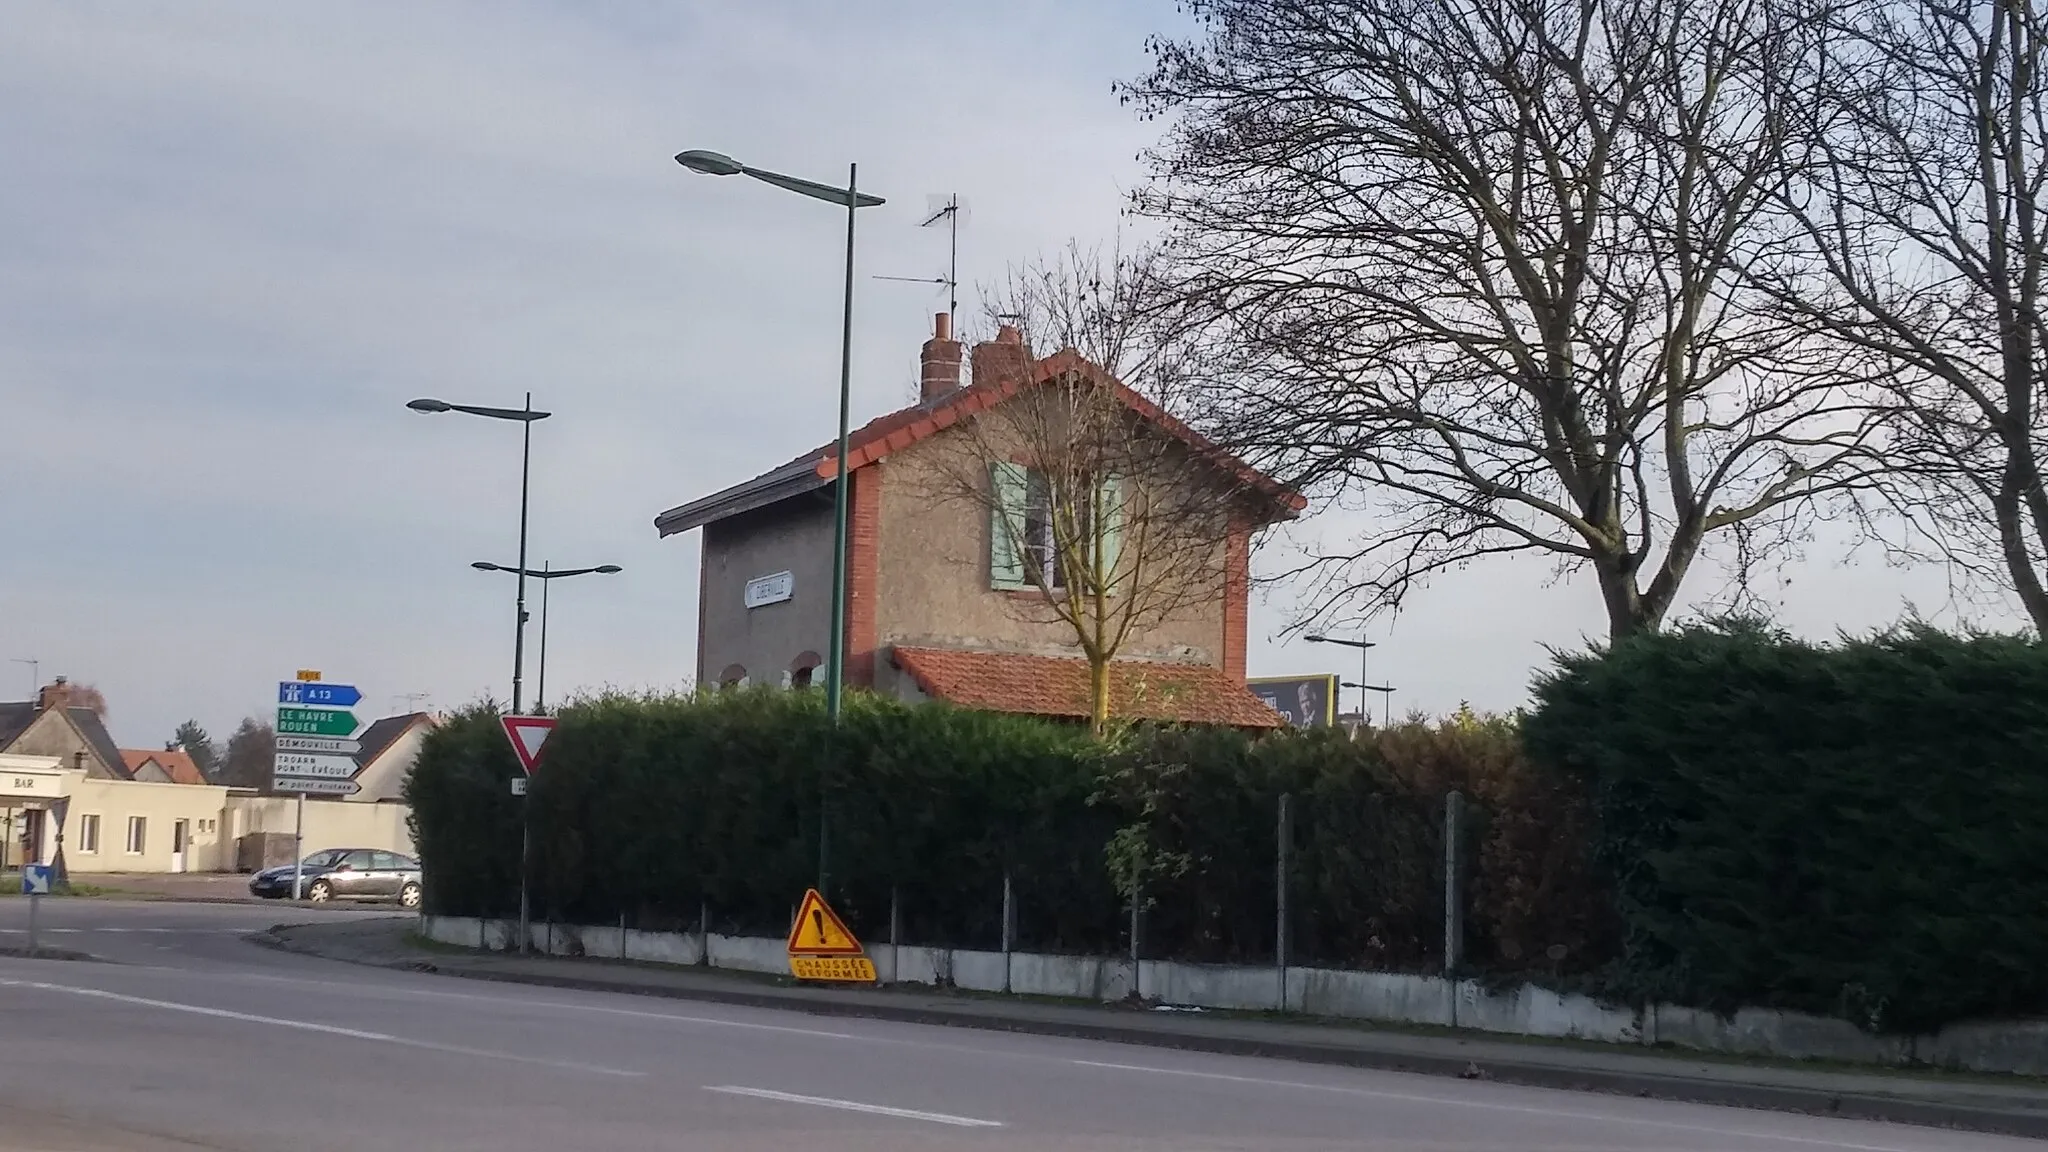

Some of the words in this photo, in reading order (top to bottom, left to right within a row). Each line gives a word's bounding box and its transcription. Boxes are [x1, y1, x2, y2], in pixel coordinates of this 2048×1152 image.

[308, 689, 317, 699] A
[320, 690, 332, 700] 13
[281, 710, 293, 720] LE
[299, 711, 334, 722] HAVRE
[280, 721, 318, 732] ROUEN
[14, 778, 34, 788] BAR
